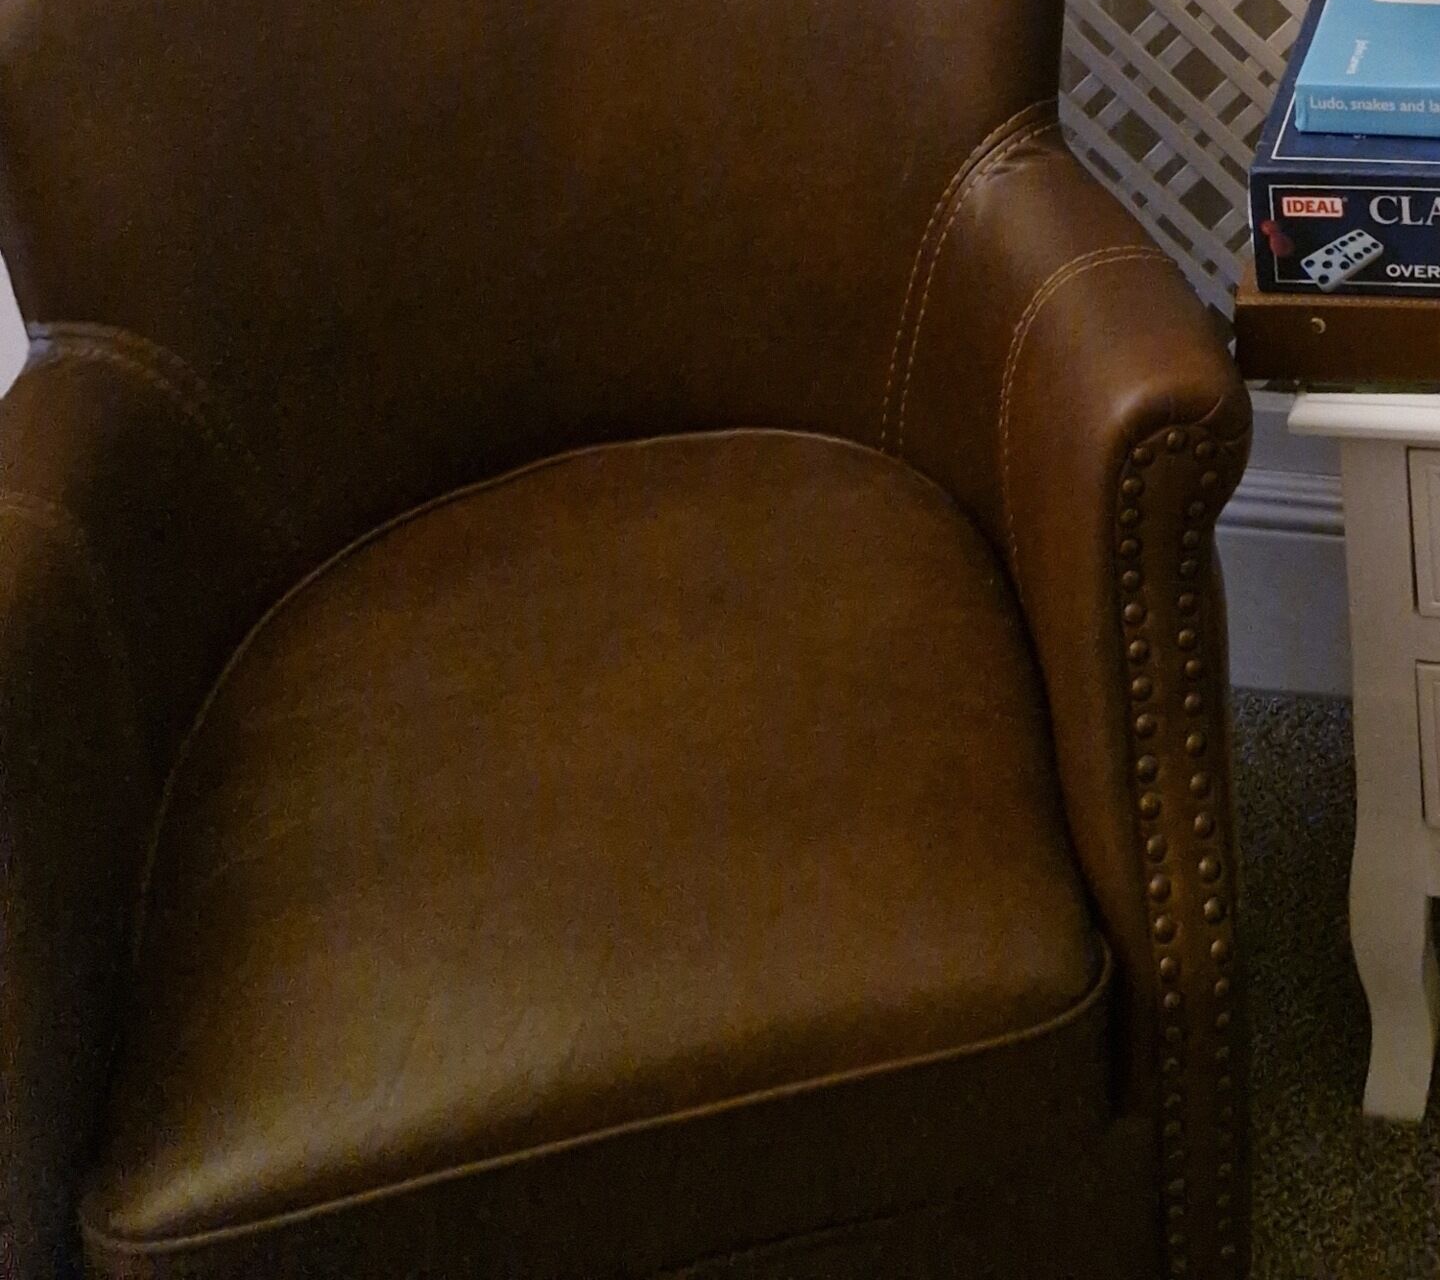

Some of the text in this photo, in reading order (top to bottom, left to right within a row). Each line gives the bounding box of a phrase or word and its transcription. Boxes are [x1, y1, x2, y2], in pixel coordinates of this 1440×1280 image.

[1309, 96, 1348, 111] Ludo,
[1351, 98, 1395, 112] snakes
[1400, 99, 1425, 113] and
[1286, 200, 1340, 214] IDEAL
[1386, 264, 1440, 279] OVER
